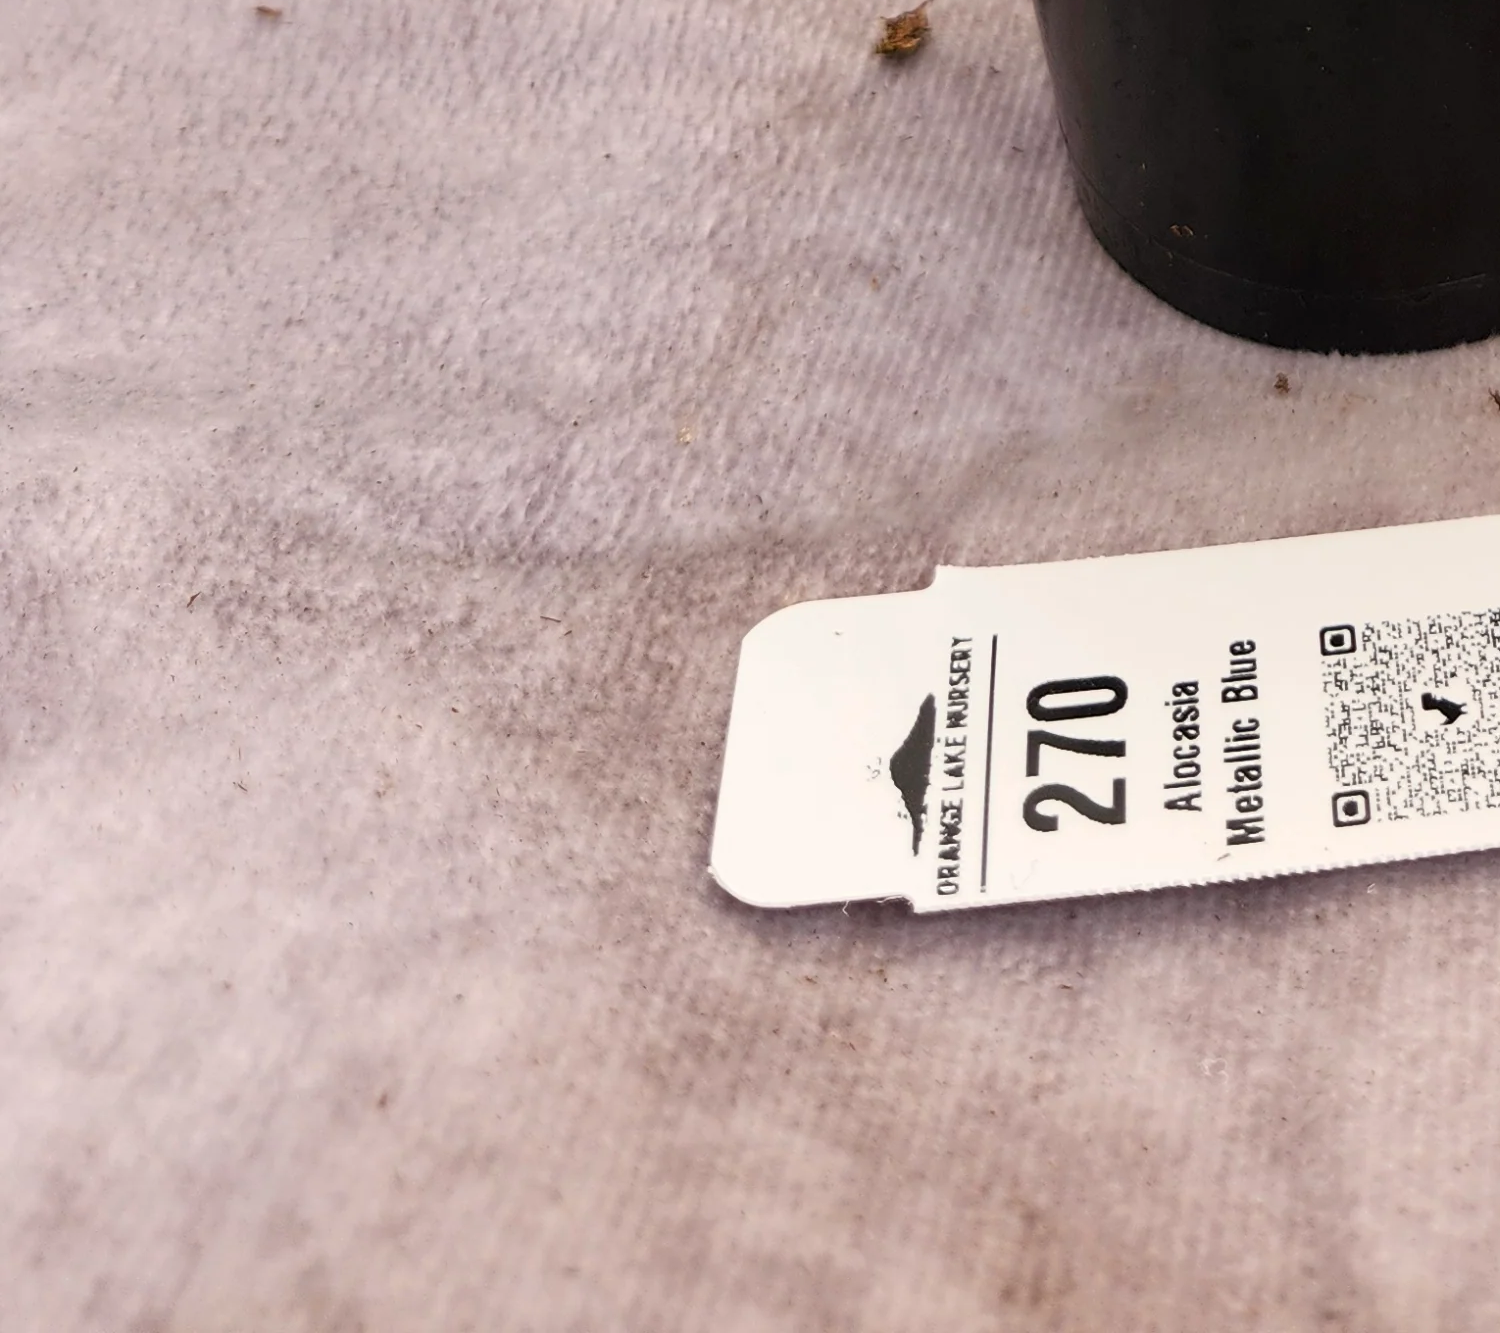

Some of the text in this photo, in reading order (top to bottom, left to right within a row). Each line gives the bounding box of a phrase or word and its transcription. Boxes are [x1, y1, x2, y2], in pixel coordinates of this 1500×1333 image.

[945, 636, 973, 730] NURSERY
[1162, 679, 1203, 813] Alocasia
[1219, 638, 1266, 846] Metallic Blue
[941, 735, 968, 792] LAKE
[1022, 674, 1130, 833] 270
